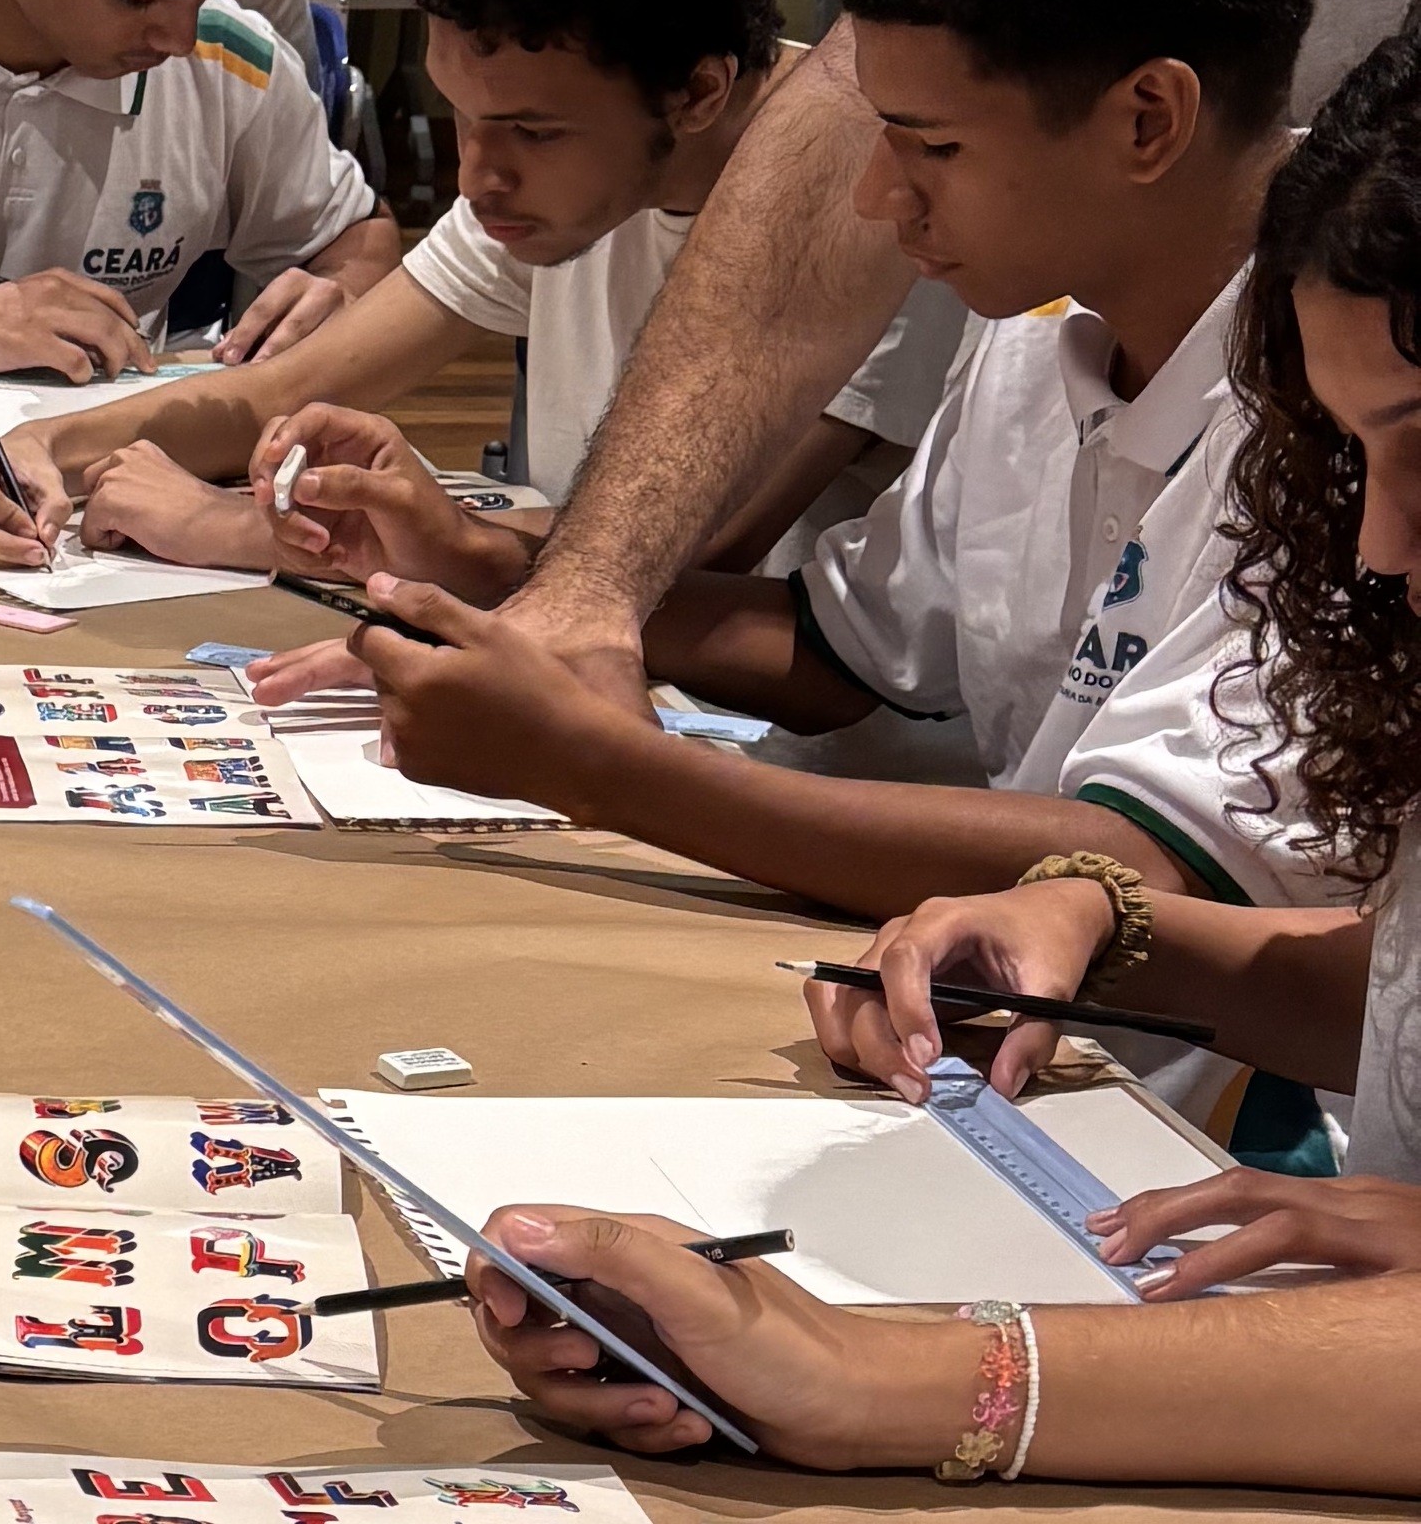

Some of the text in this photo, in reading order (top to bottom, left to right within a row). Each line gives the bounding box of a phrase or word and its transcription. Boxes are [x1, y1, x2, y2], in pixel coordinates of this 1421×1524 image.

[82, 236, 185, 275] CEARÁ
[18, 1128, 139, 1194] S
[11, 1220, 138, 1288] M
[69, 1468, 219, 1503] E
